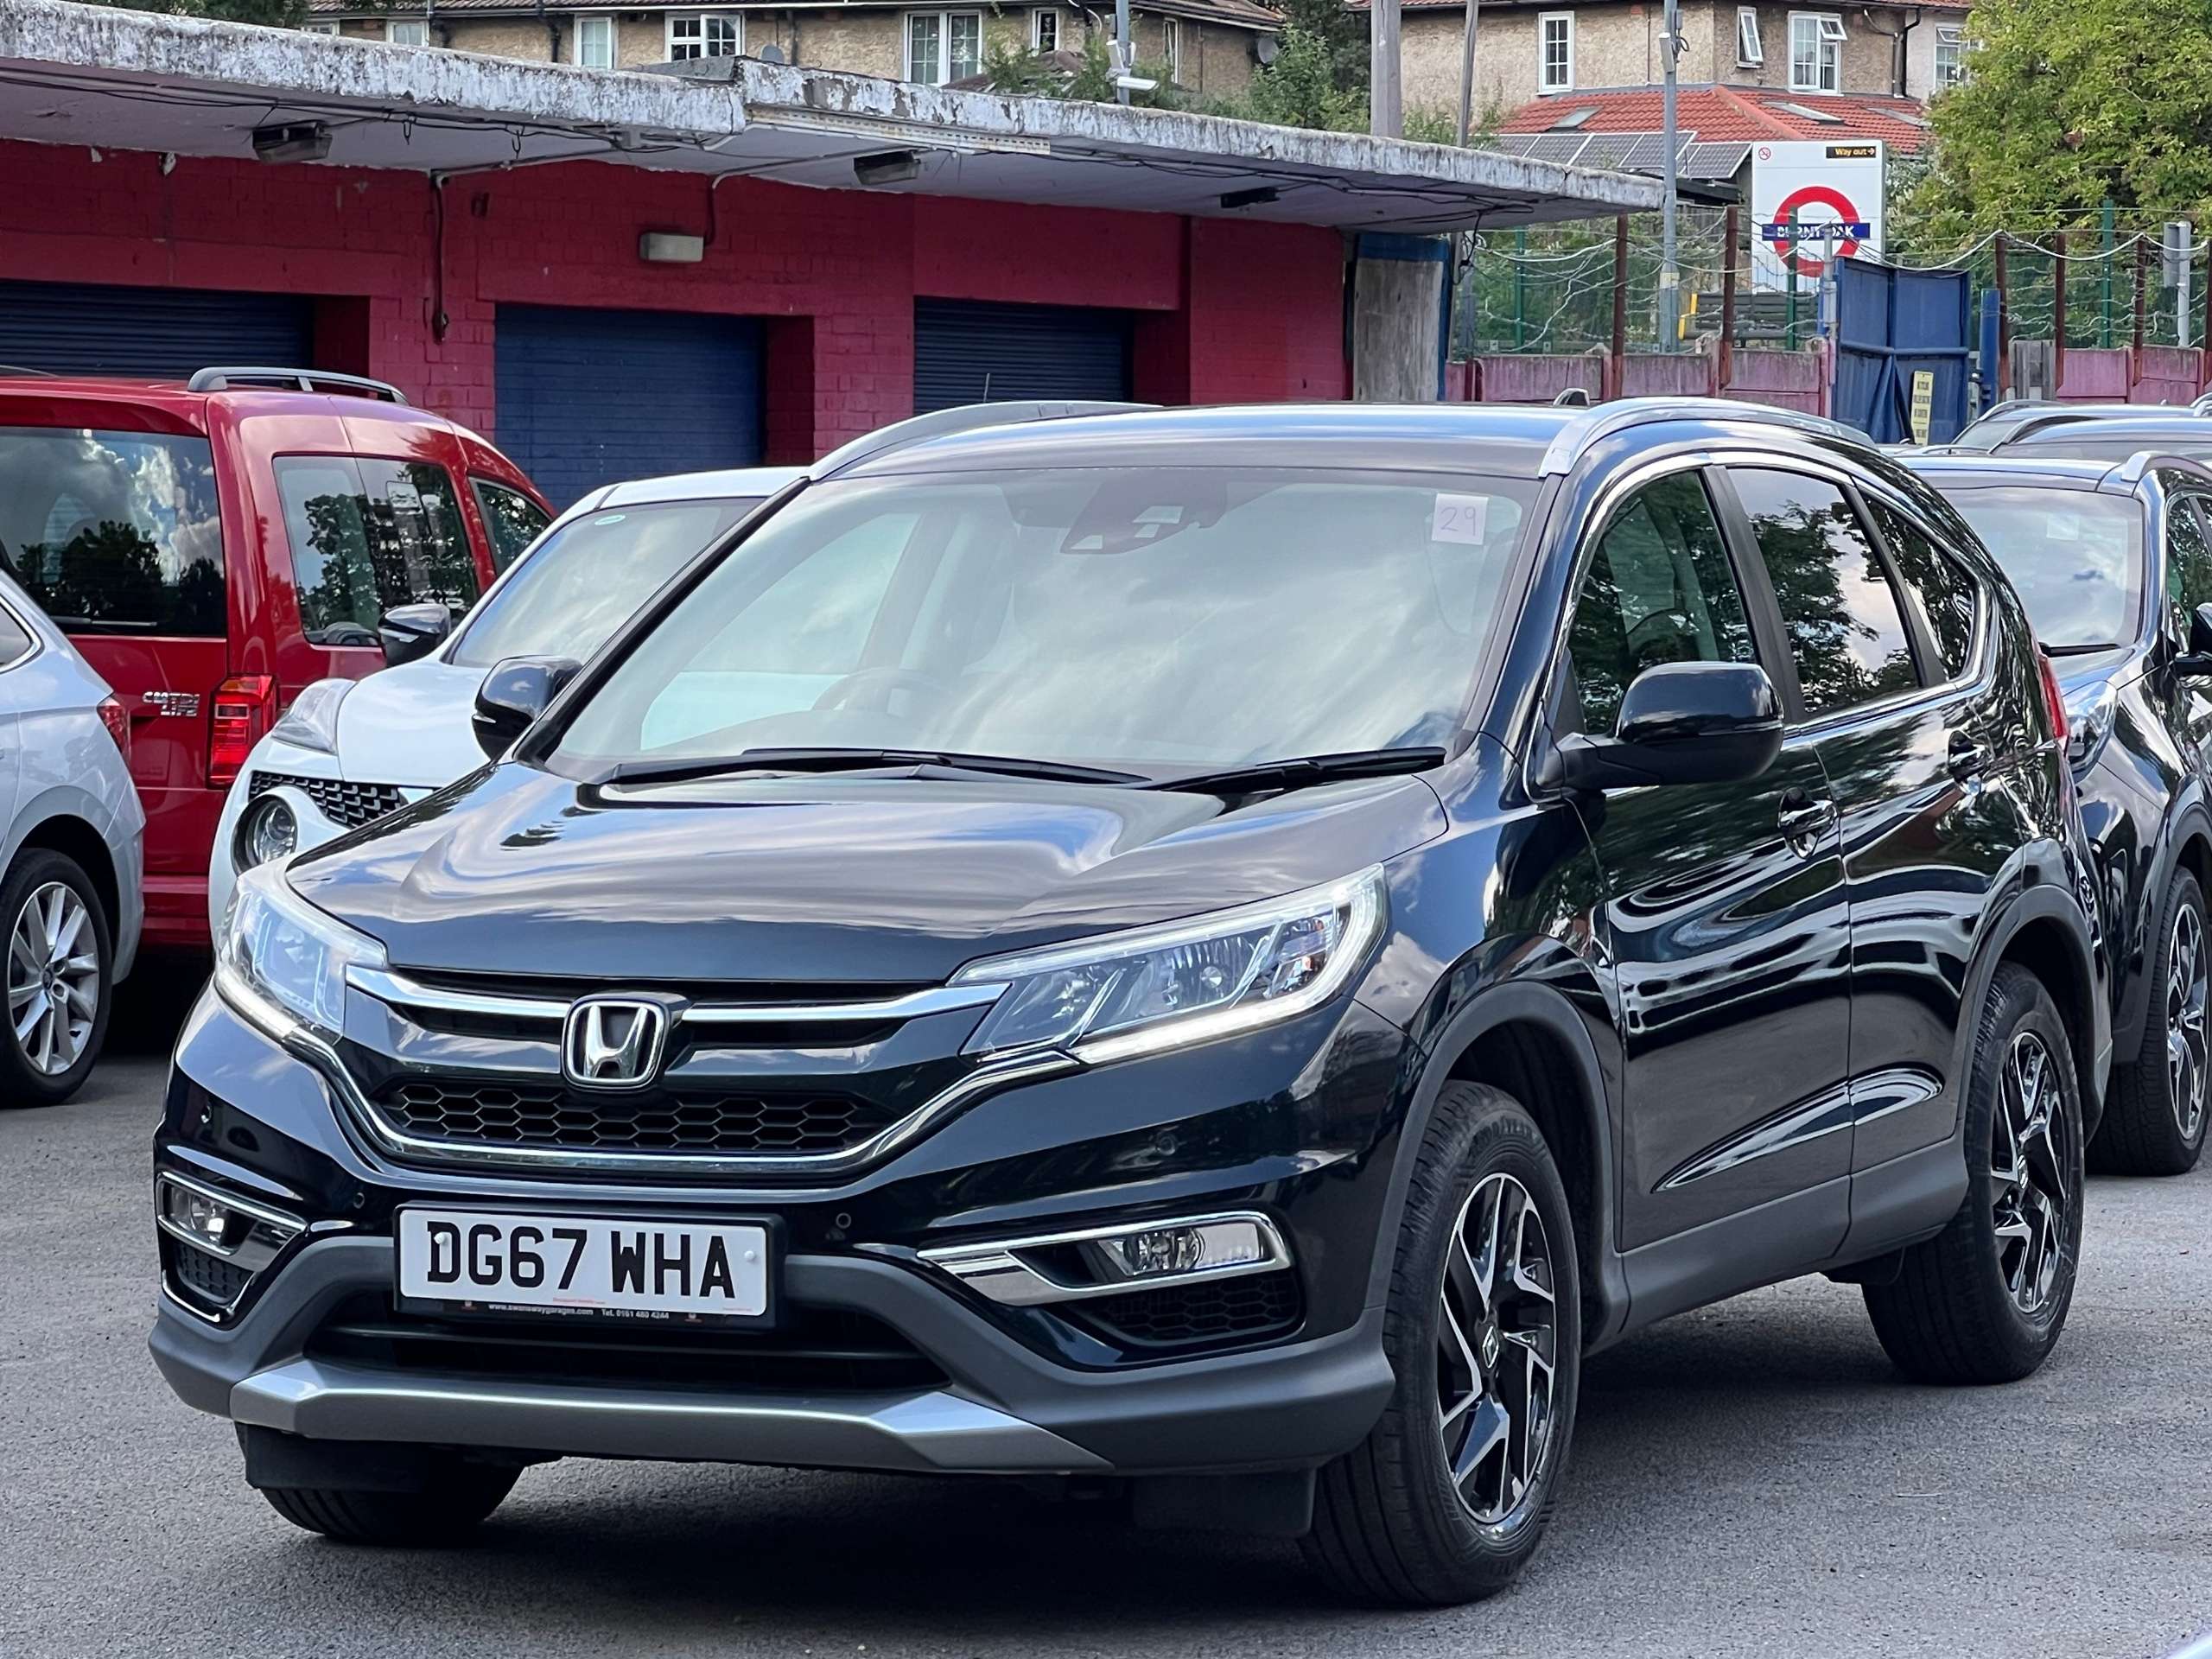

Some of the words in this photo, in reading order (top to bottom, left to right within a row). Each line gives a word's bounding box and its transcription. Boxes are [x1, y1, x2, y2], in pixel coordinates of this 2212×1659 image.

[1834, 148, 1852, 156] Way
[1440, 506, 1477, 537] 29
[427, 1220, 588, 1290] DG67
[610, 1230, 735, 1299] WHA
